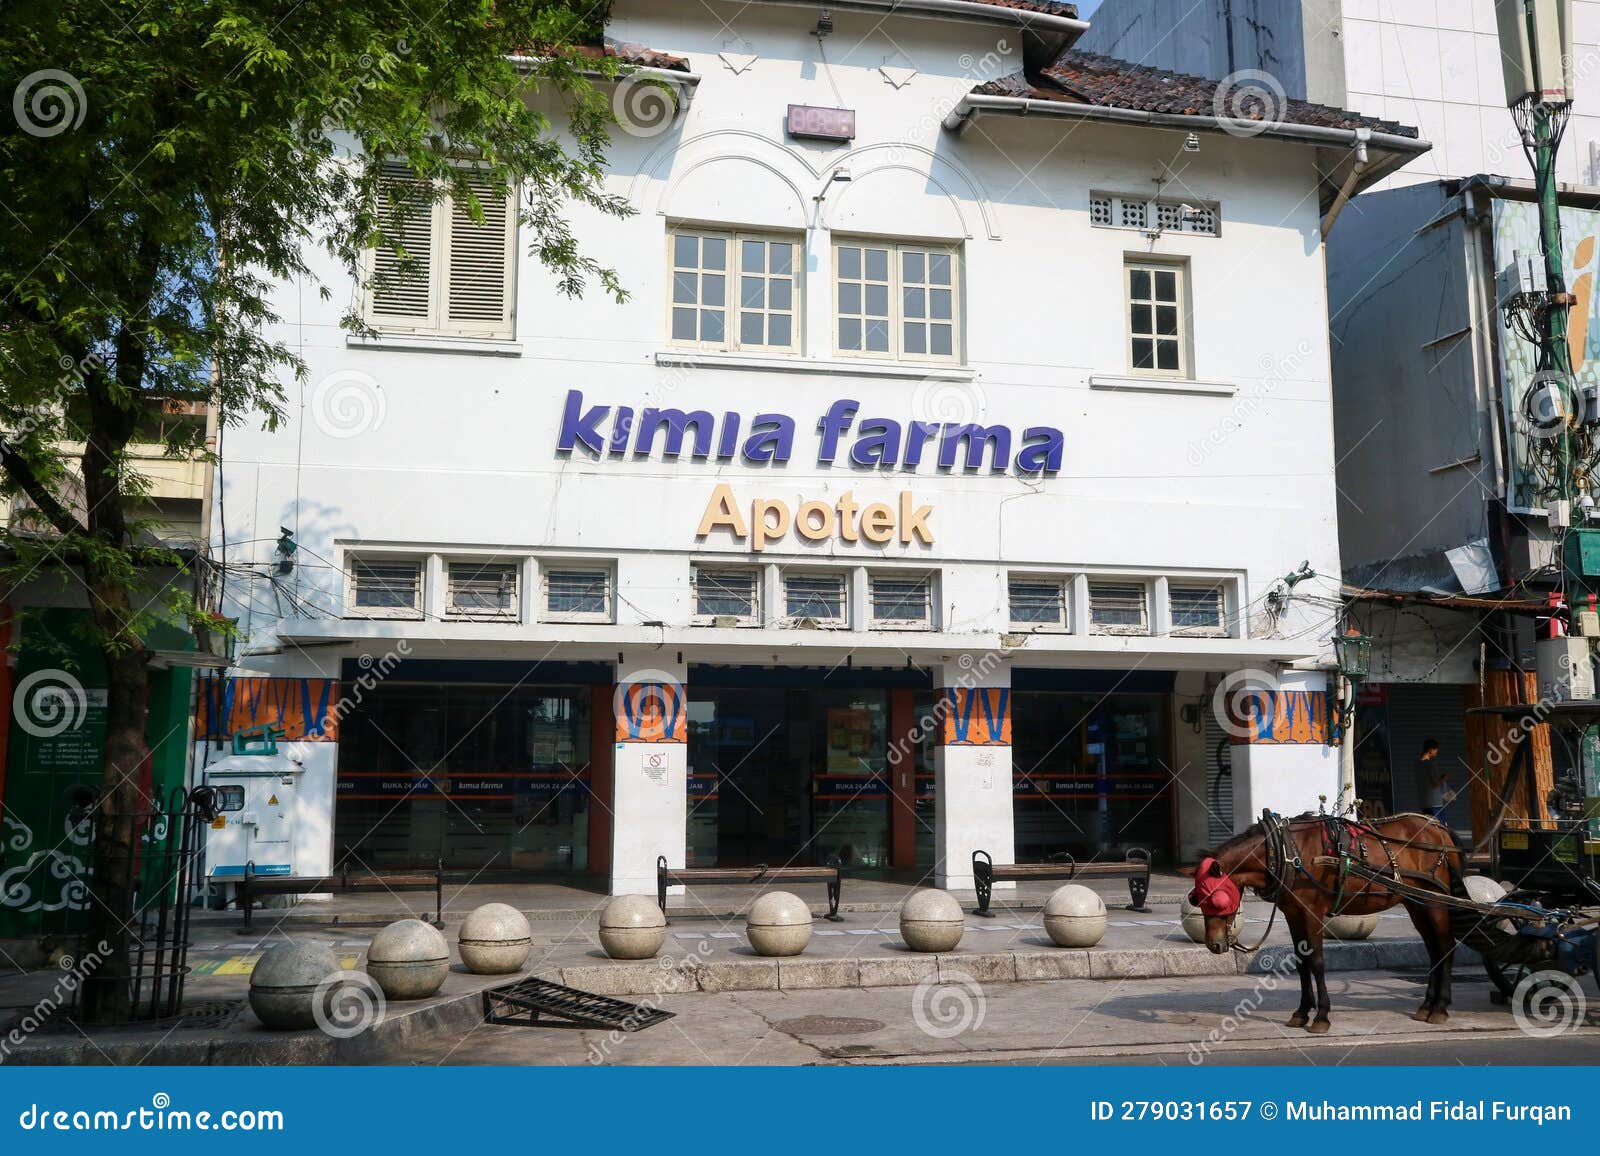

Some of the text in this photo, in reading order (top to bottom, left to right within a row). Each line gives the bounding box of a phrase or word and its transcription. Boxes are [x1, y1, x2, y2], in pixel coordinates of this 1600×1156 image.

[557, 389, 1066, 474] kimia farma
[696, 483, 935, 551] Apotek
